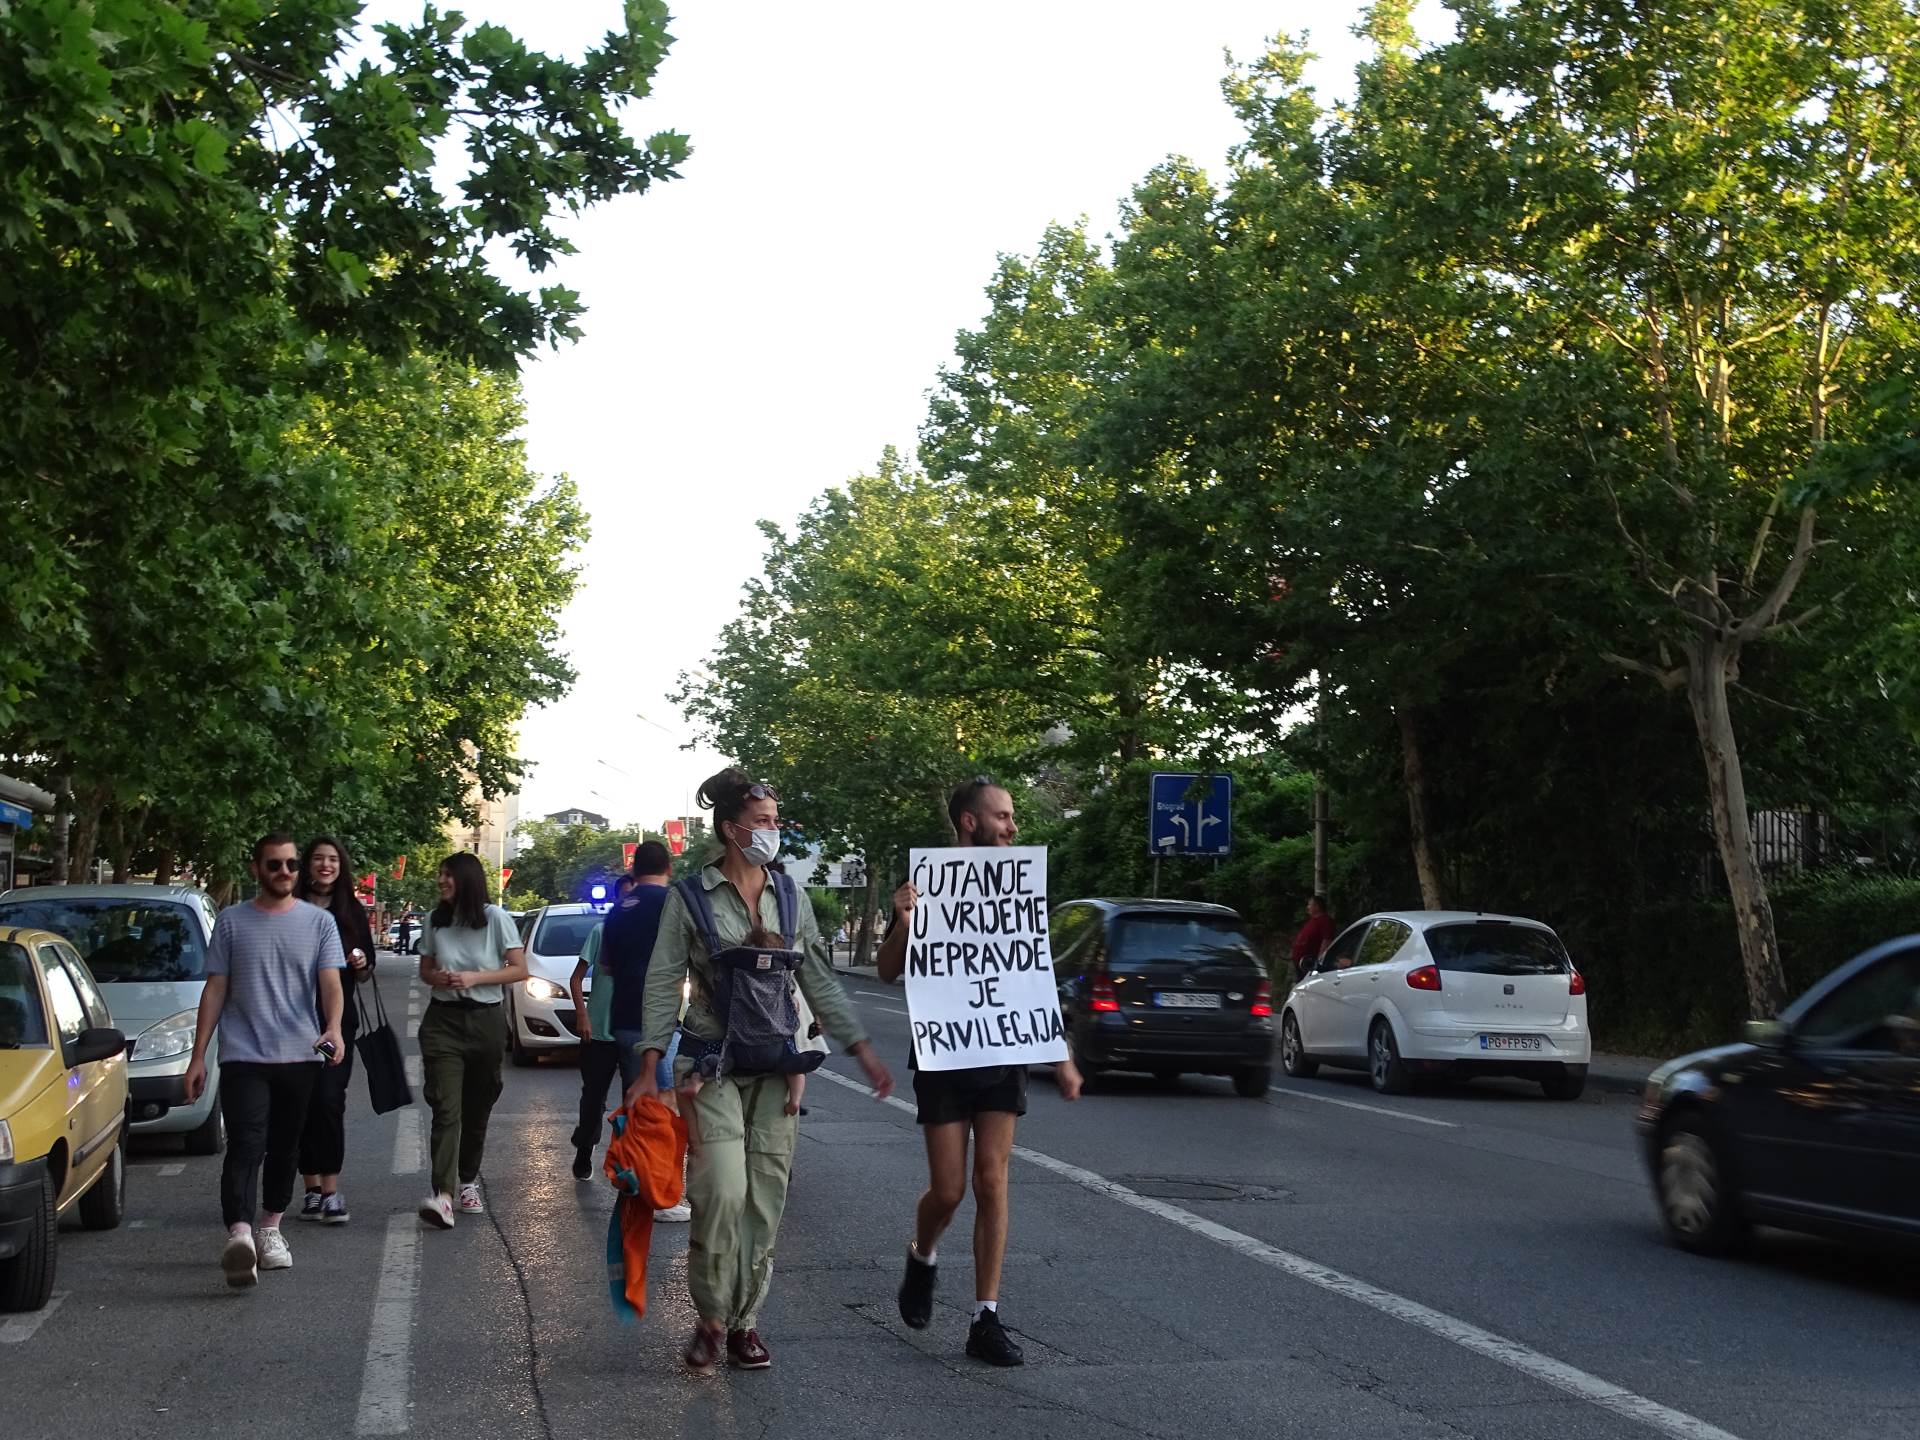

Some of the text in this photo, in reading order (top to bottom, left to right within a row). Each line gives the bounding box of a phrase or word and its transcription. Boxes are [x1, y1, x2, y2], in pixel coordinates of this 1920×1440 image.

[913, 856, 1033, 897] ĆUTANJE
[913, 897, 1047, 940] U VRIJEME
[909, 938, 1050, 978] NEPRAVDE
[968, 977, 1005, 1009] JE
[913, 1008, 1067, 1056] PRIVILEGIJA
